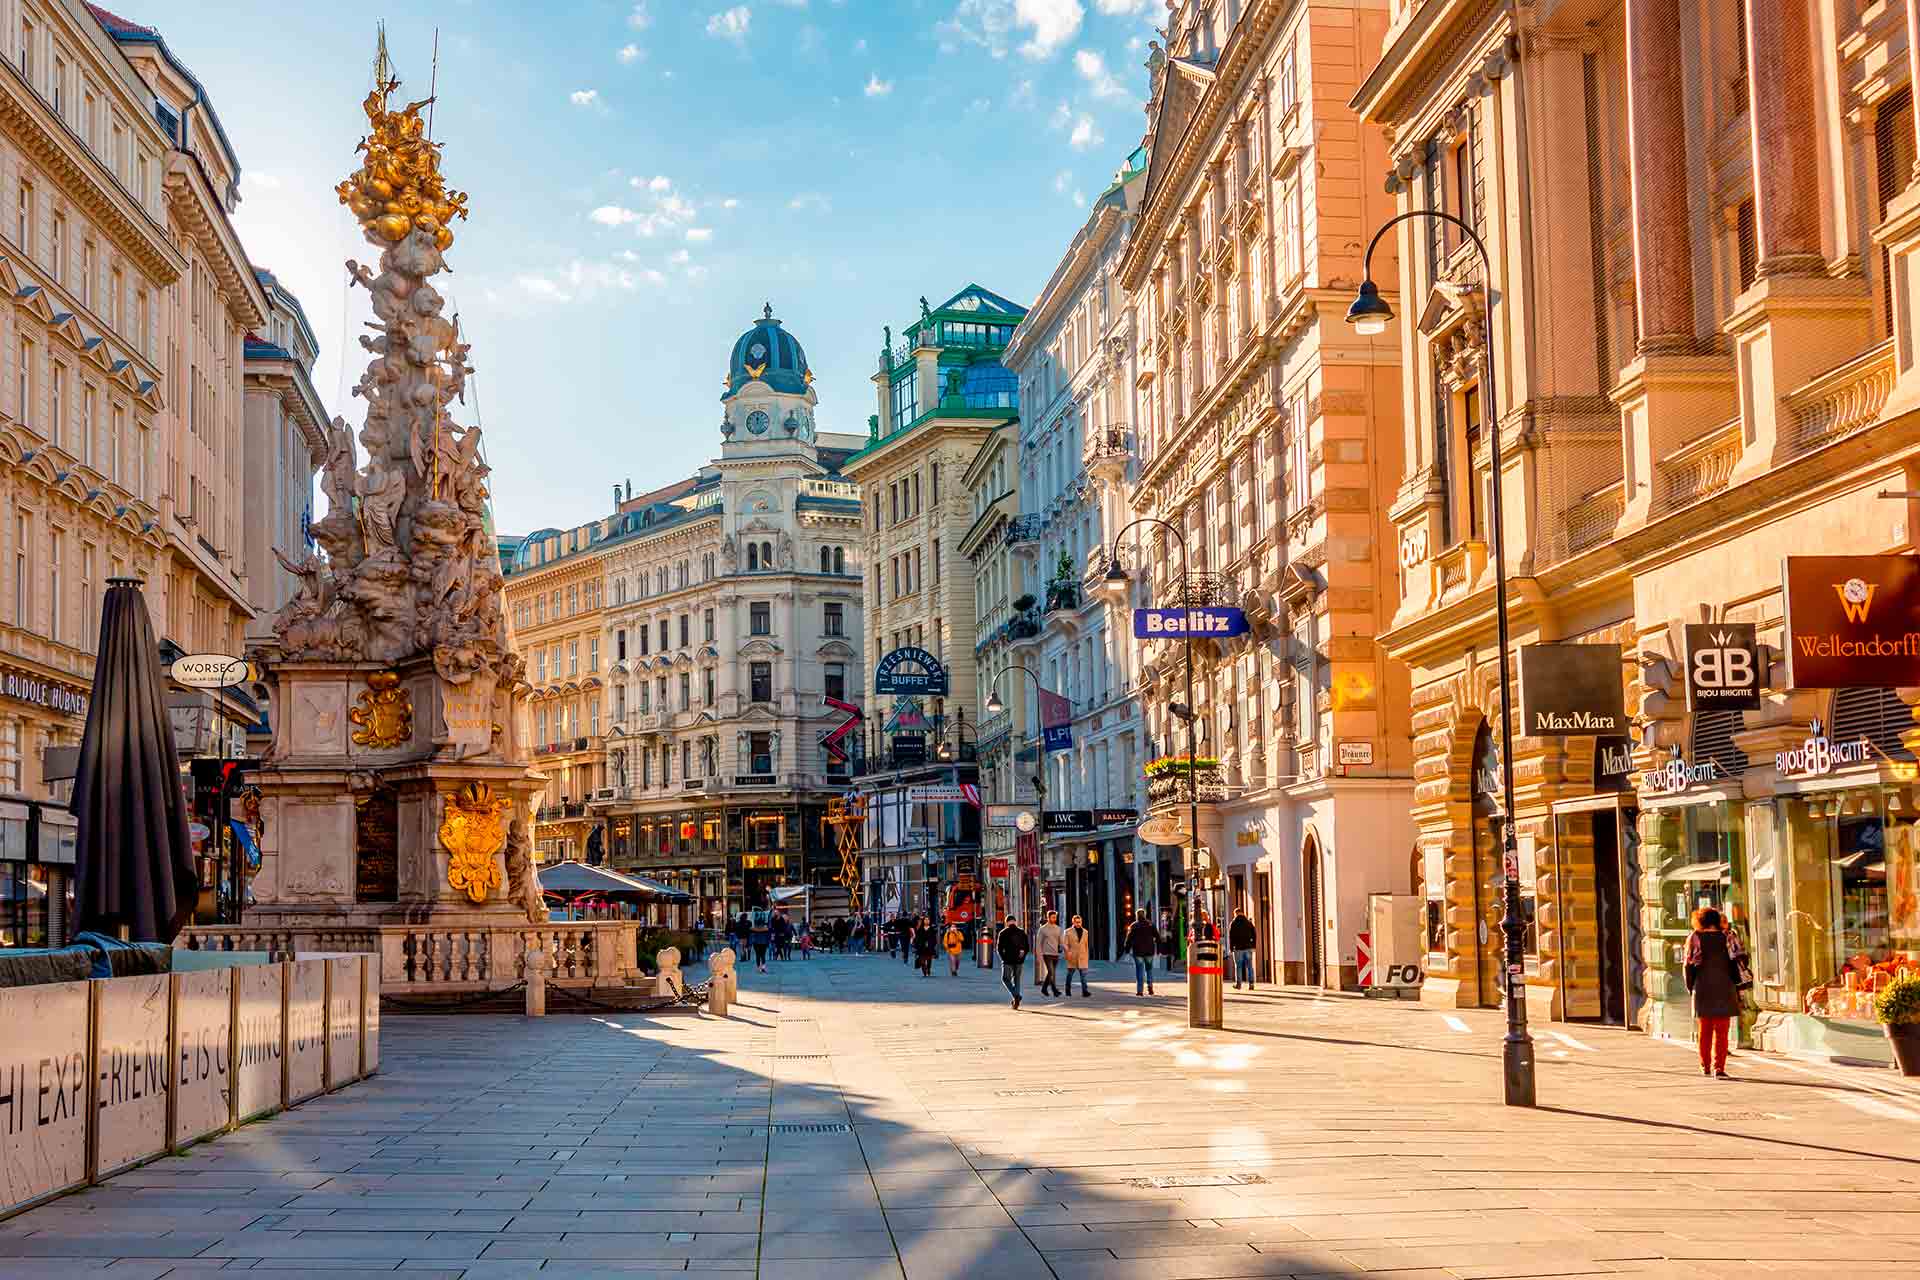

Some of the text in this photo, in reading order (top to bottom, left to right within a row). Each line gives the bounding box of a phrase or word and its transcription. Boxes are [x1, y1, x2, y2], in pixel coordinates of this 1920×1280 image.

[1146, 612, 1229, 632] Berlitz
[182, 663, 236, 673] WORSEG
[891, 676, 929, 685] BUFFET
[1536, 711, 1615, 730] MaxMara
[1055, 813, 1077, 824] IWC
